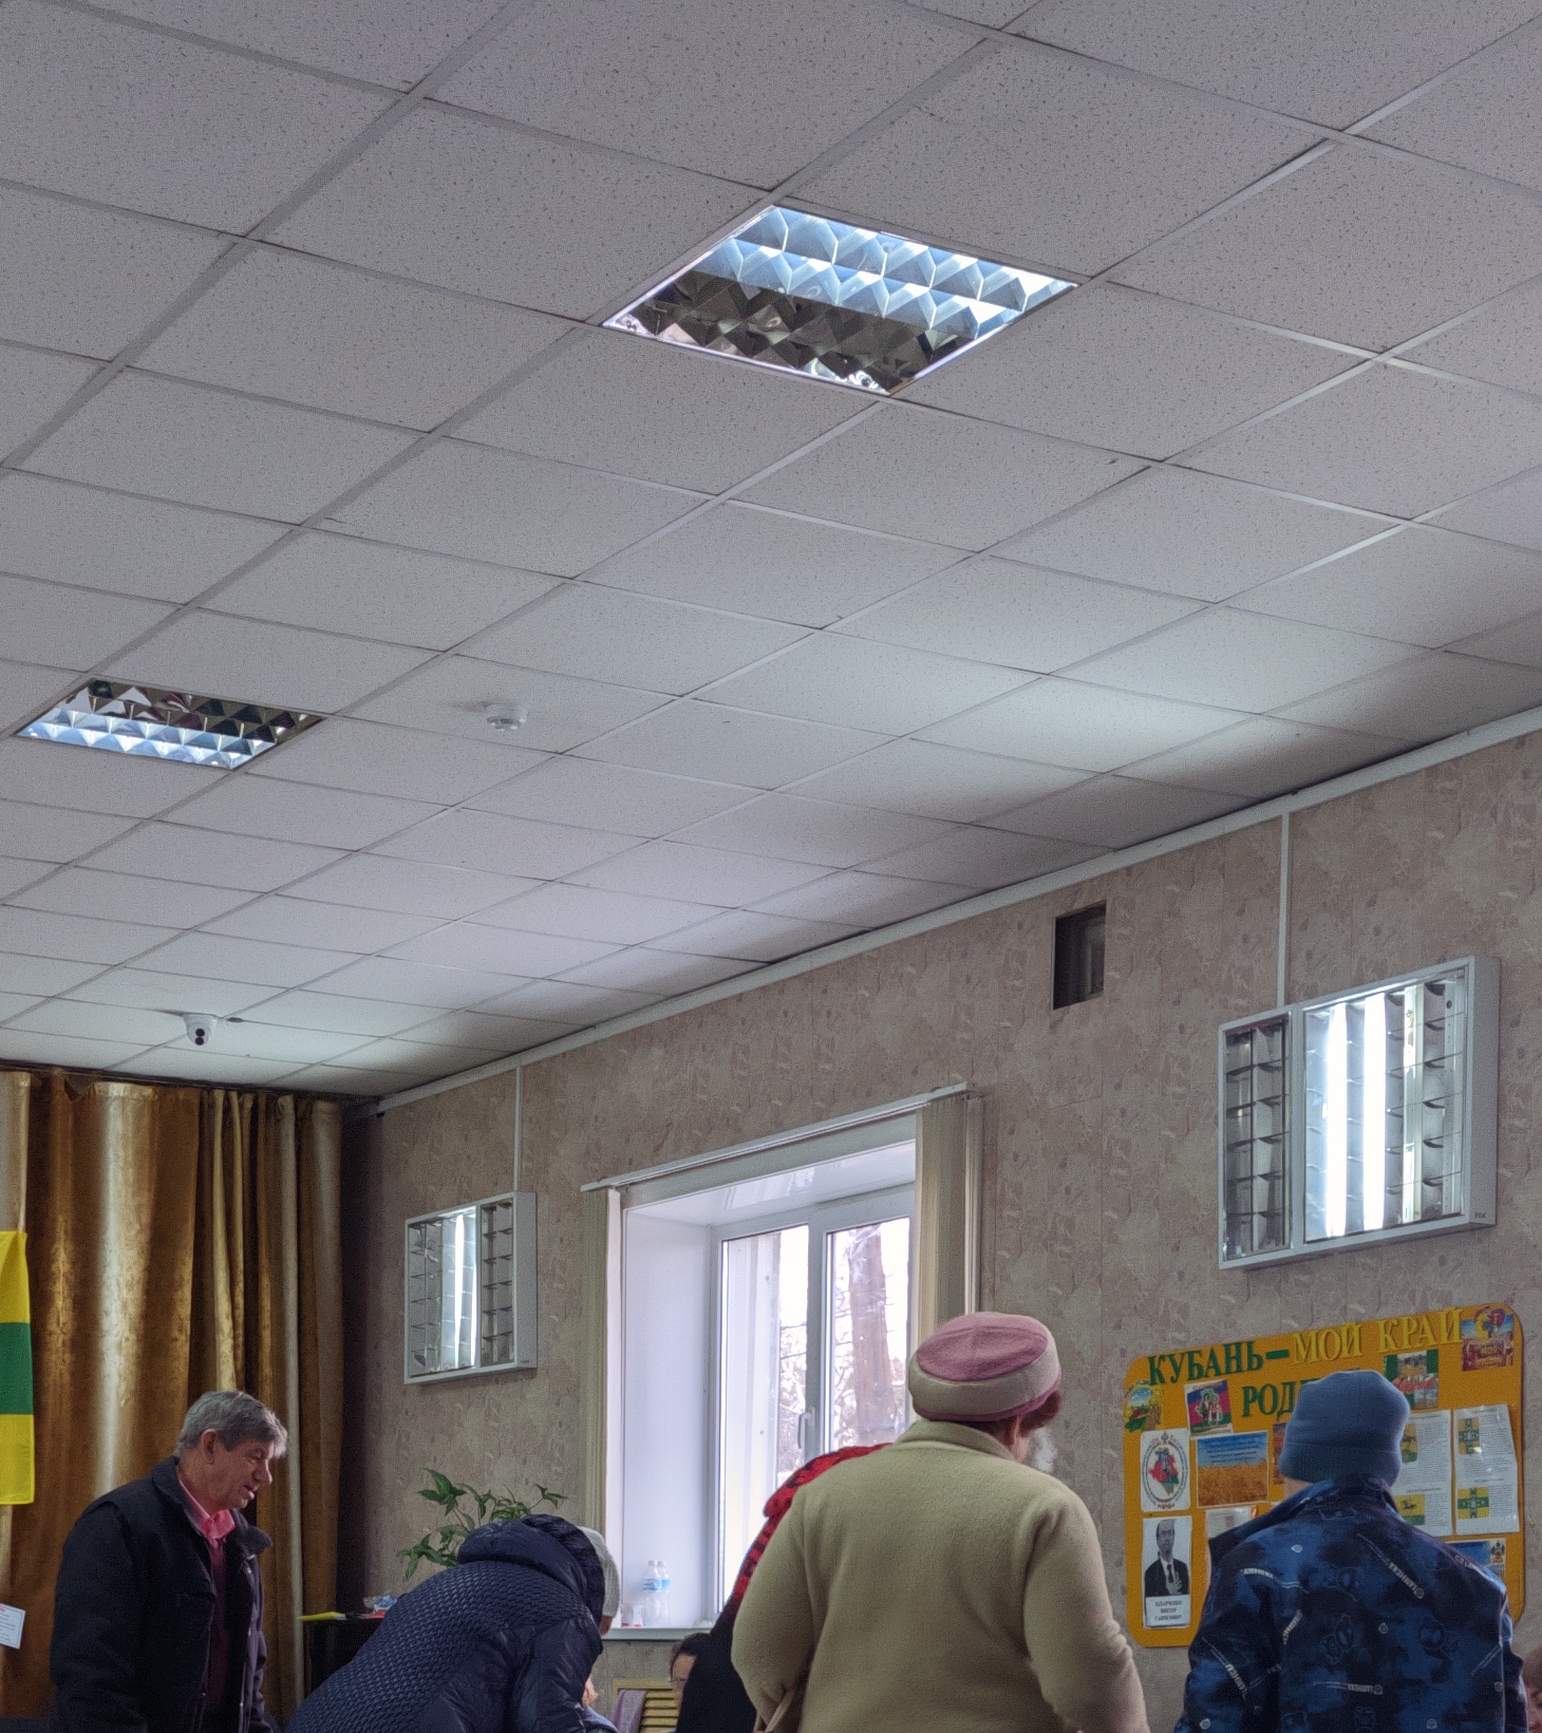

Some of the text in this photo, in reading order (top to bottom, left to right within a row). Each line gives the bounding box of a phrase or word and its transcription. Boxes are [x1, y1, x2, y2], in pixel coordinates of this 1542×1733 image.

[1148, 1341, 1264, 1386] КУБАНЬ
[1292, 1322, 1363, 1365] МОЙ
[1376, 1307, 1464, 1353] КРАЙ
